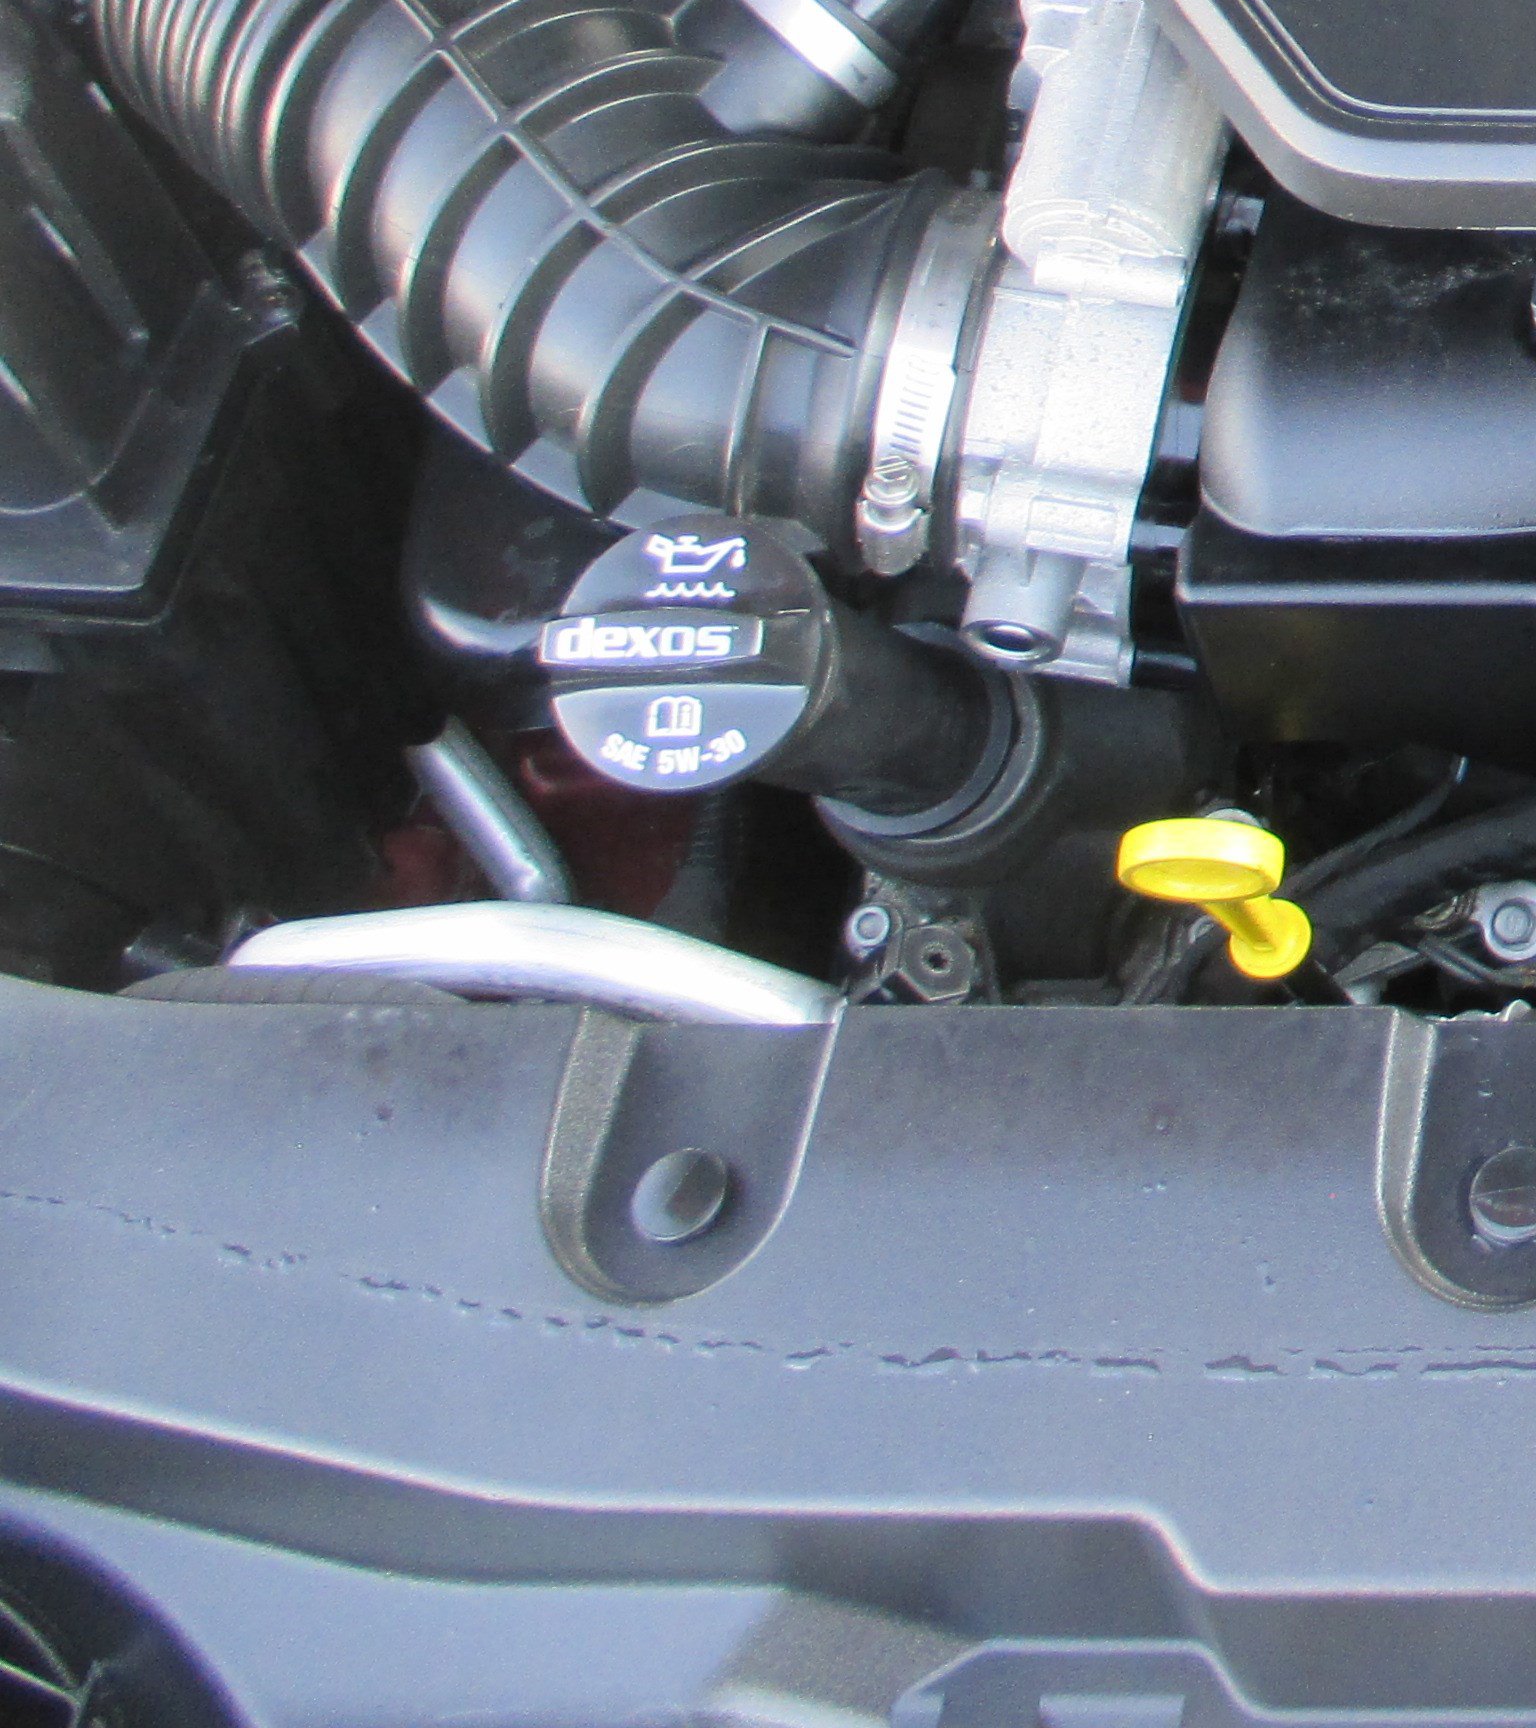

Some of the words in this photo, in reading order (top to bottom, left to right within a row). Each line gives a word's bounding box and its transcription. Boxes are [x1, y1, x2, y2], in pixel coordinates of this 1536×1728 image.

[556, 618, 733, 658] dexos
[601, 733, 649, 771] SAE
[656, 729, 747, 776] 5W-30
